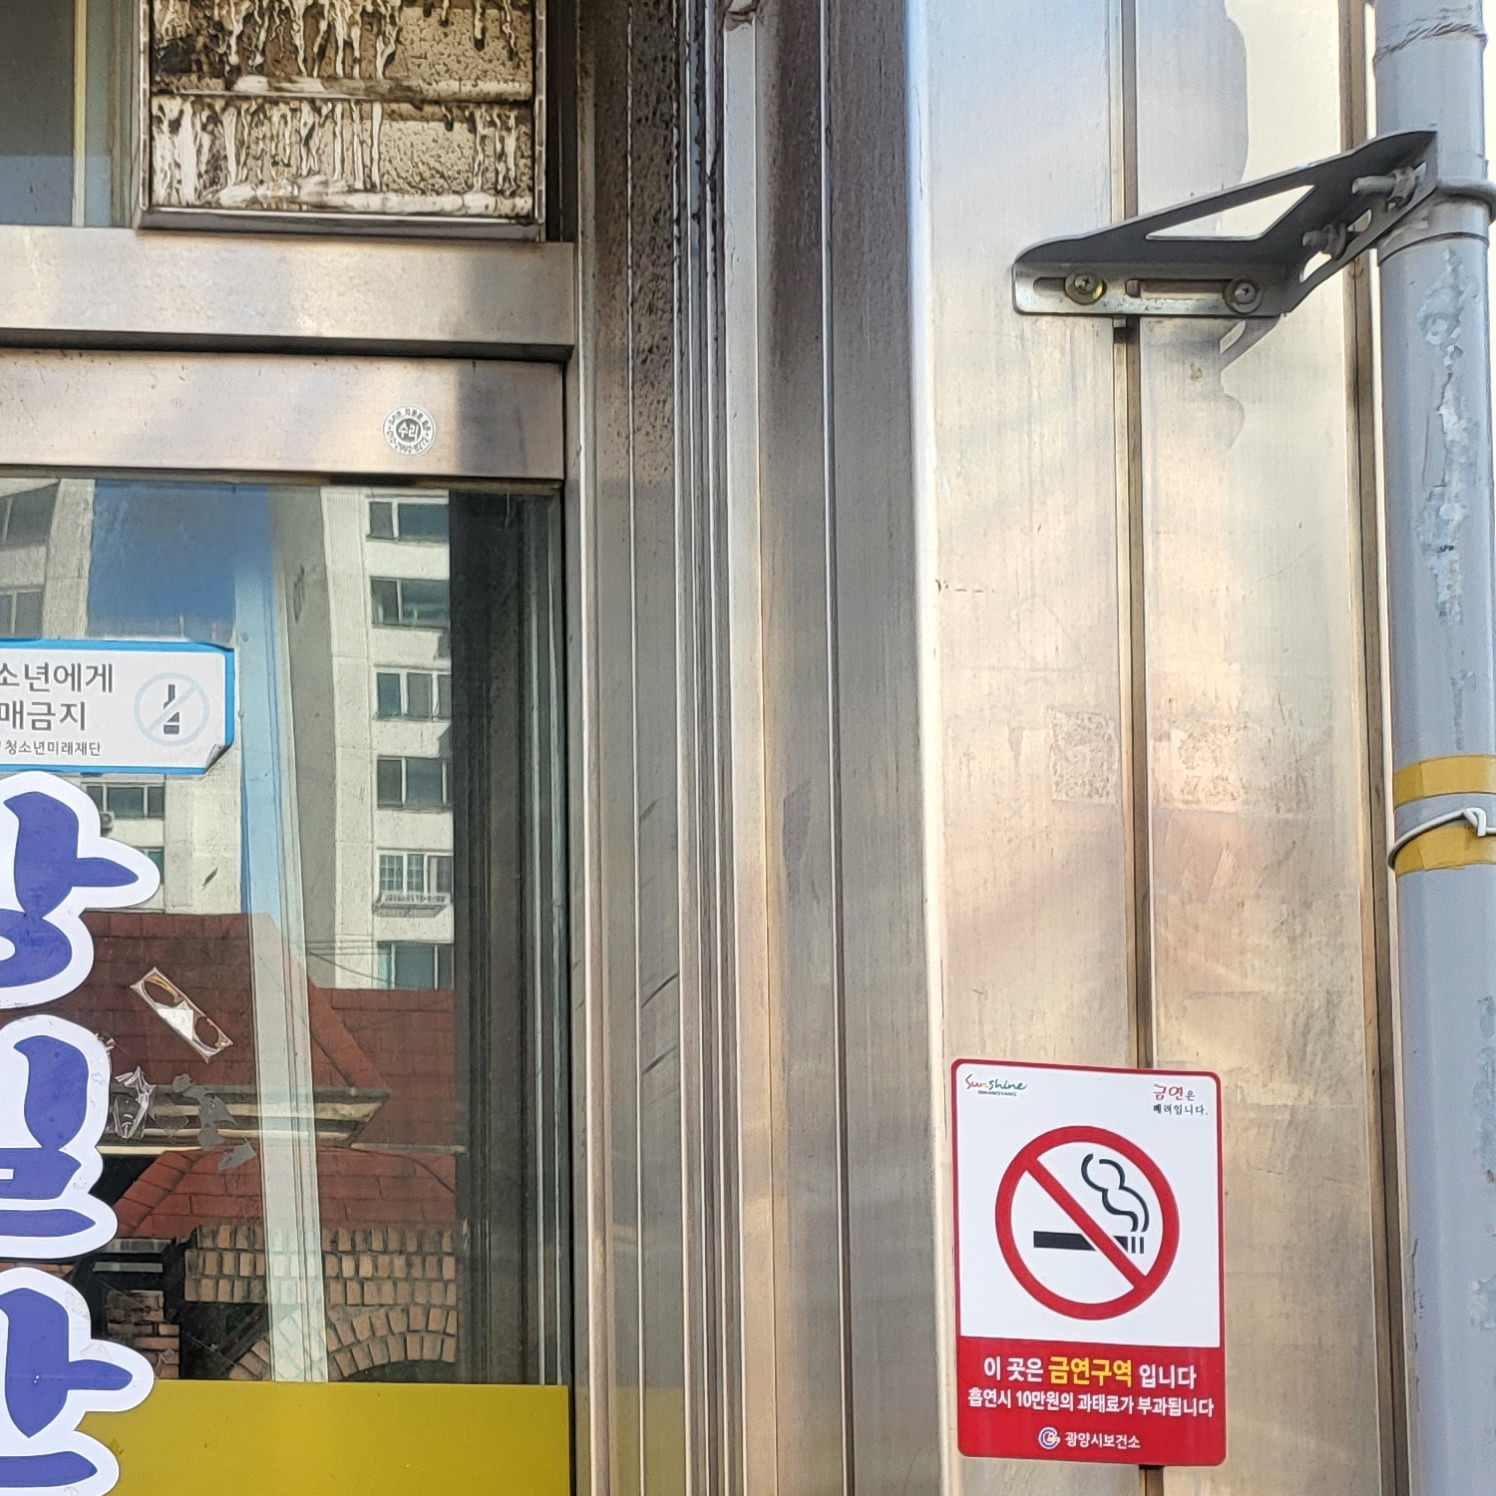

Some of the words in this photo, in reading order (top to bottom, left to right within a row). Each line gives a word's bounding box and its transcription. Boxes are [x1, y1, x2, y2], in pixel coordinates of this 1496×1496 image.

[397, 420, 420, 441] 수리
[965, 1073, 1029, 1091] Sunshine
[1152, 1083, 1196, 1102] 금연은
[983, 1355, 1002, 1381] 이
[1006, 1357, 1045, 1383] 곳은
[1047, 1355, 1133, 1388] 금연구역
[1139, 1363, 1198, 1390] 입니다
[967, 1387, 1012, 1409] 흡연시
[1015, 1391, 1075, 1412] 10만원의
[1076, 1393, 1135, 1415] 과태료가
[1136, 1396, 1215, 1418] 부과됩니다
[1064, 1431, 1142, 1450] 광양시보건소
